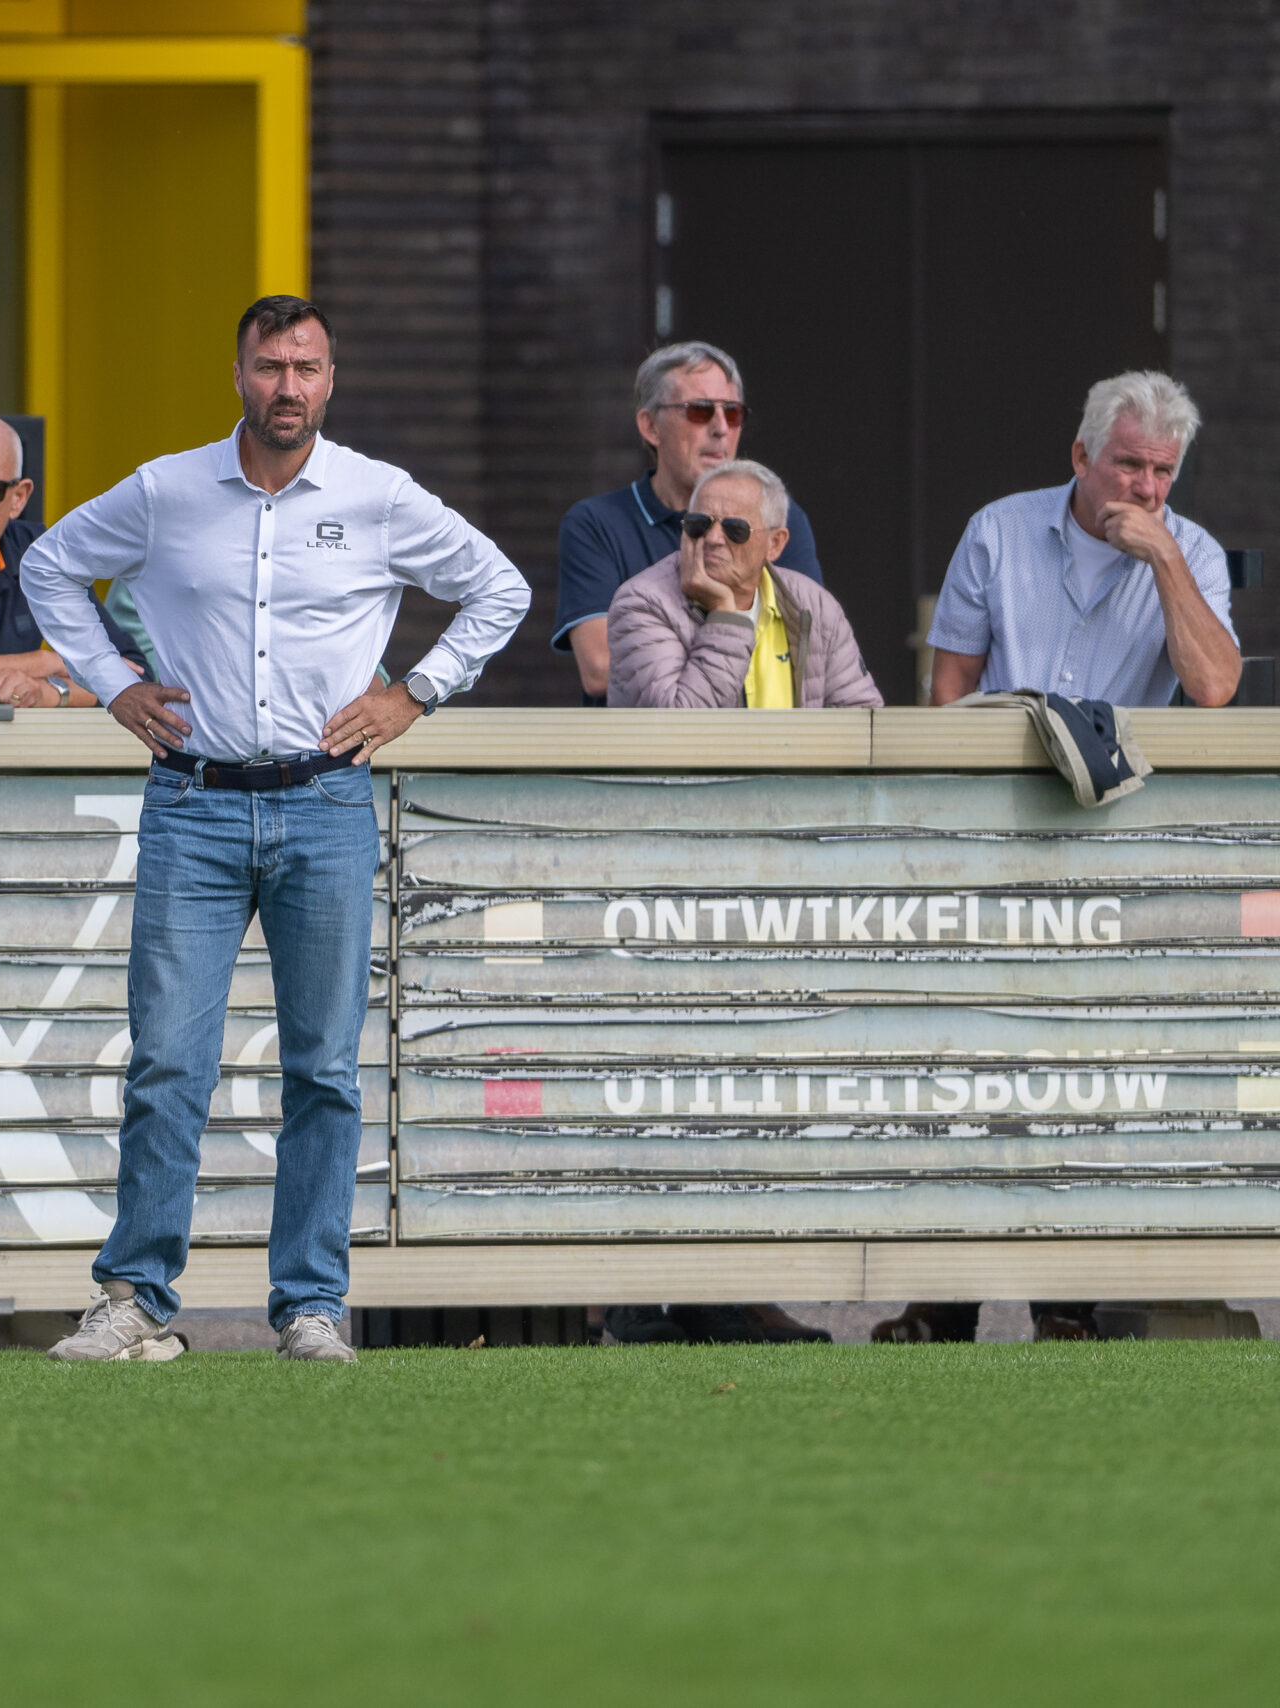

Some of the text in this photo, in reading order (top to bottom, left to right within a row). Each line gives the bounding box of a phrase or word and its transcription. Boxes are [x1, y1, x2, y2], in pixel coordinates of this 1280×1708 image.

[316, 521, 344, 541] G
[306, 541, 352, 551] LEVEL
[604, 895, 1122, 945] ONTWIKKELING
